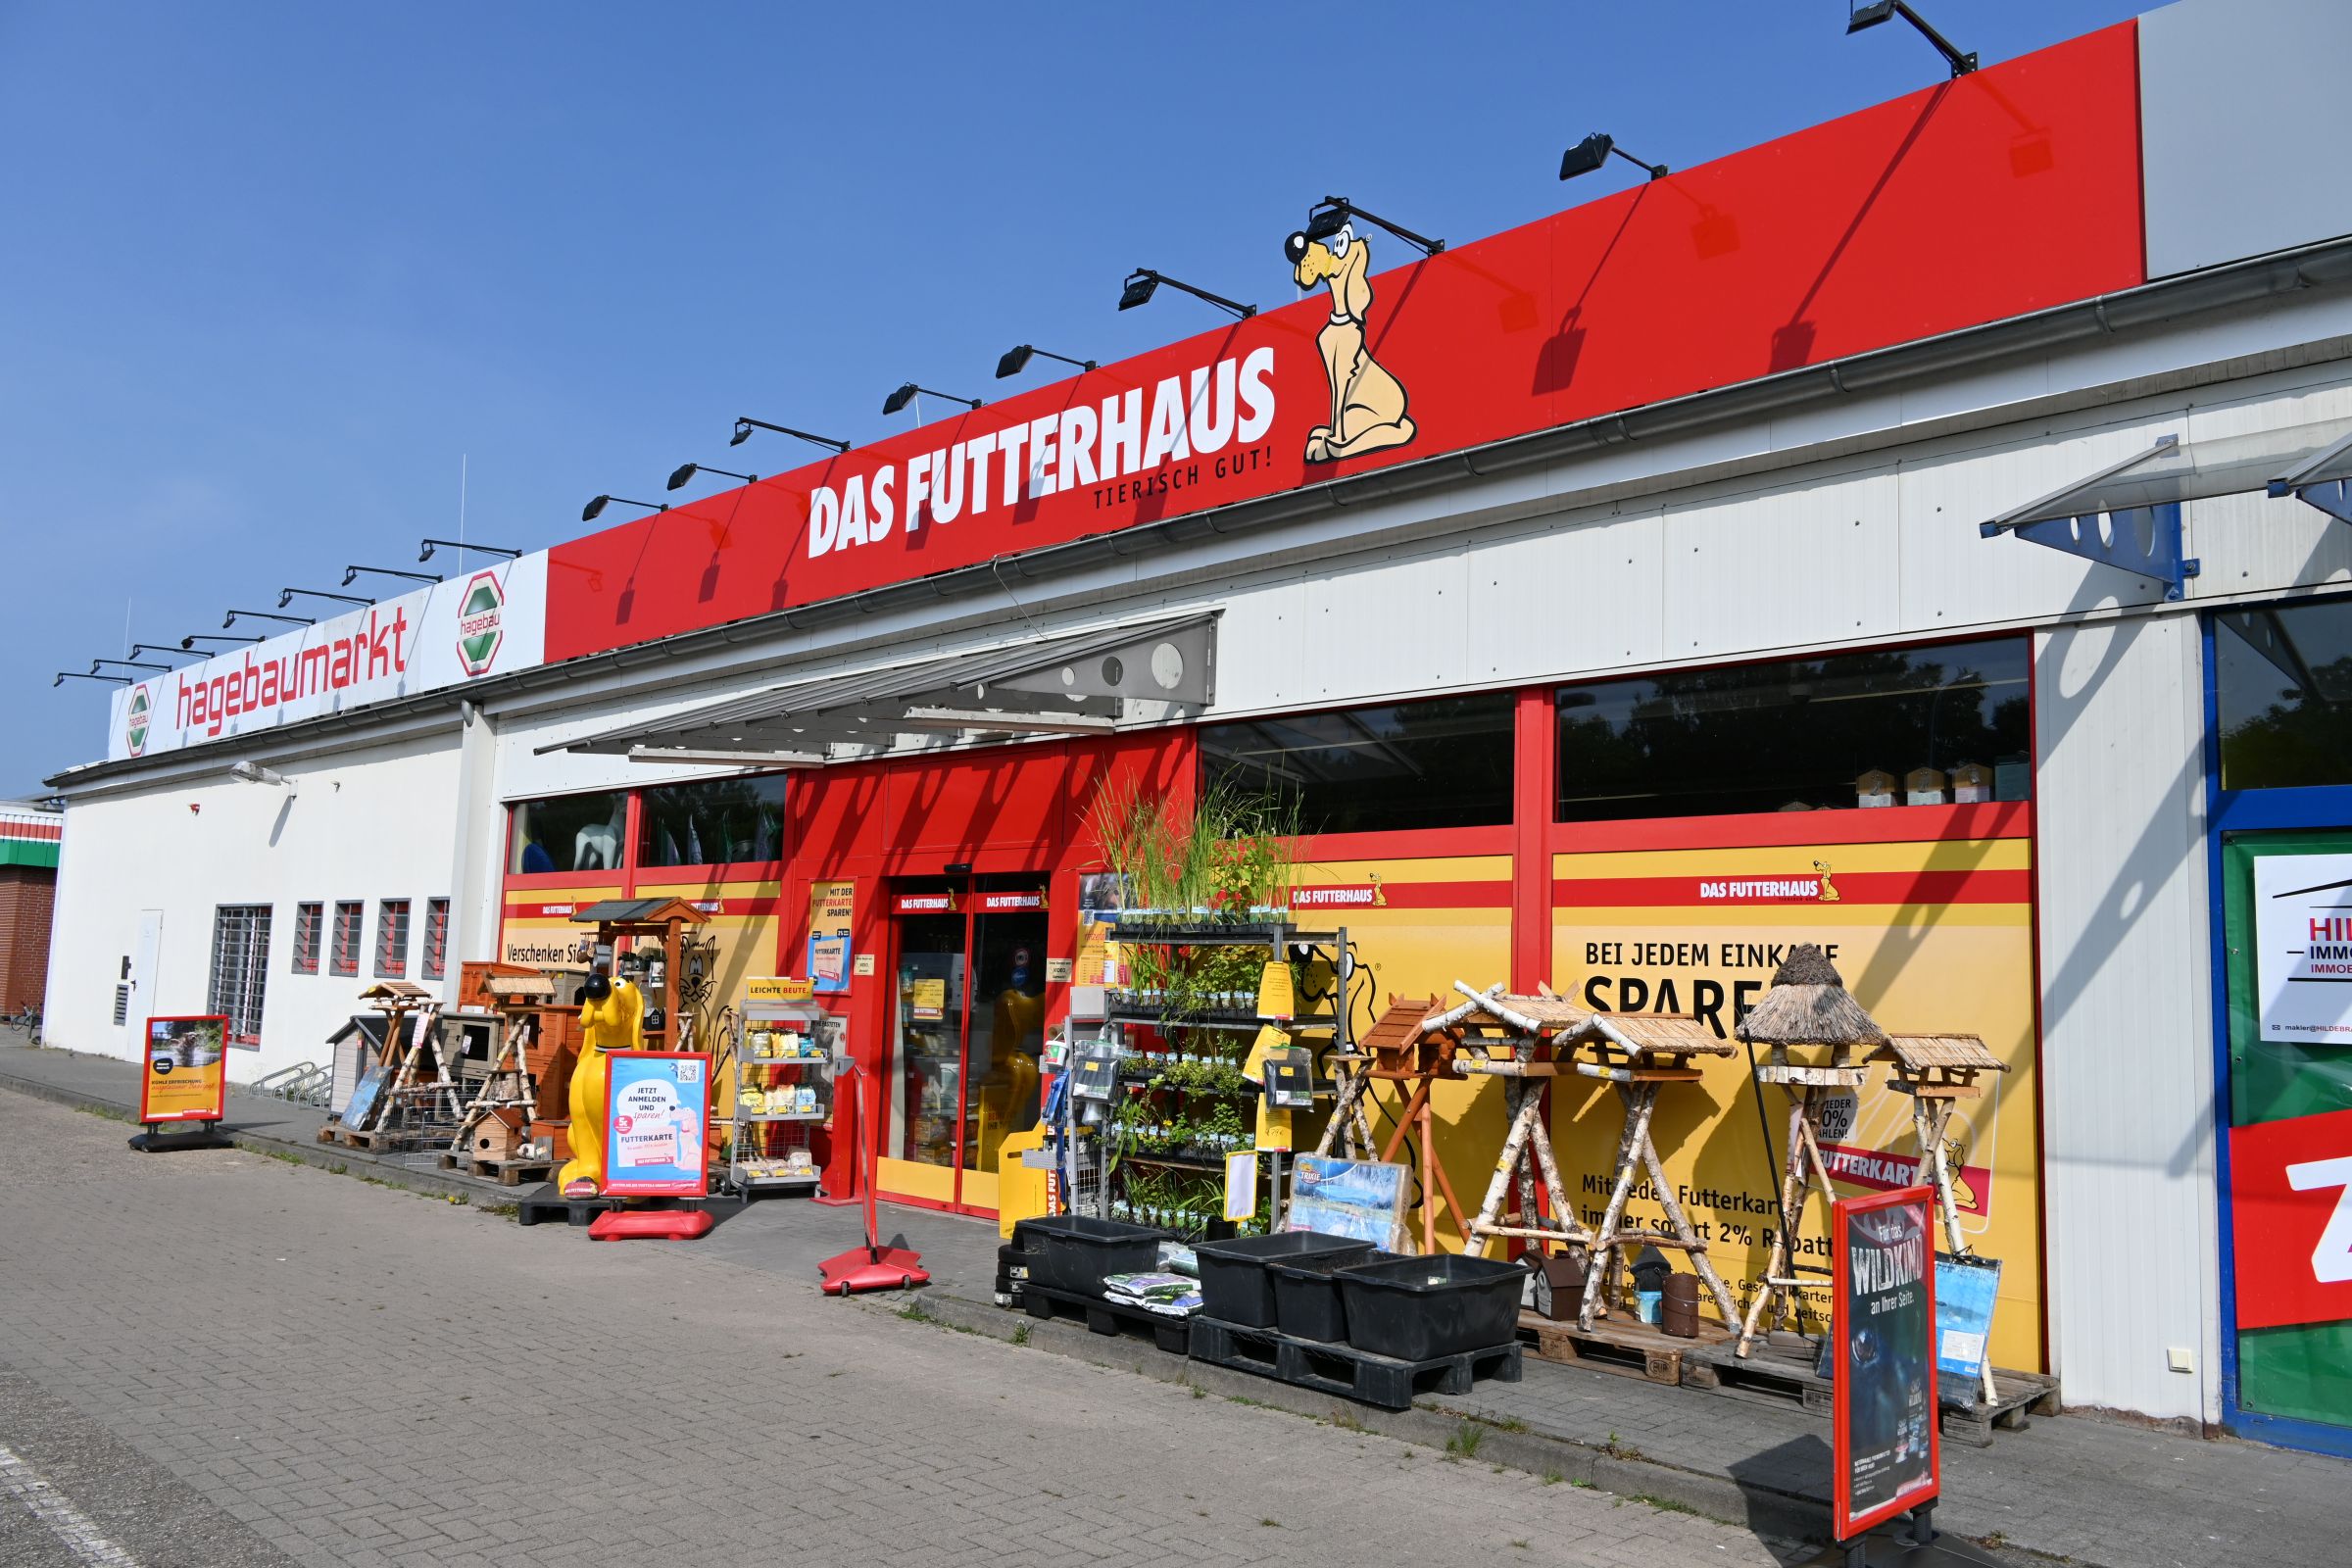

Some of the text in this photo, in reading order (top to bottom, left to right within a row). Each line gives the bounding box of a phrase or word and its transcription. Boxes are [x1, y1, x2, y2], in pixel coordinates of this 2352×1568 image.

[808, 347, 1276, 559] DAS FUTTERHAUS
[1094, 446, 1271, 509] TIERISCH GUT!
[460, 612, 501, 636] hagebau
[175, 607, 408, 736] hagebaumarkt
[841, 887, 853, 896] DER
[1293, 889, 1373, 904] DAS FUTTERHAUS
[1700, 880, 1818, 898] DAS FUTTERHAUS
[812, 898, 853, 906] FUTTERKARTE
[901, 898, 949, 908] DAS FUTTERHAUS
[986, 896, 1041, 907] DAS FUTTERHAUS
[826, 908, 852, 917] SPAREN!
[507, 943, 564, 962] Verschenken
[1586, 942, 1839, 967] BEI JEDEM EINKAF
[2310, 946, 2352, 959] IMM
[1584, 975, 1763, 1040] SPARE
[633, 1108, 665, 1122] sparen!
[1822, 1109, 1848, 1128] 0%
[620, 1133, 673, 1143] FUTTERKARTE
[1818, 1128, 1848, 1139] AHLEN!
[1300, 1171, 1321, 1181] TRIXIE
[1582, 1174, 1613, 1196] Mit
[1679, 1185, 1780, 1215] Futterkar
[1651, 1218, 1711, 1240] sort
[1719, 1222, 1753, 1247] 2%
[1762, 1228, 1834, 1257] Rbatt
[1879, 1223, 1903, 1242] Für das
[1850, 1234, 1923, 1296] WILDKIND
[1871, 1290, 1915, 1315] an Ihrer Seite.
